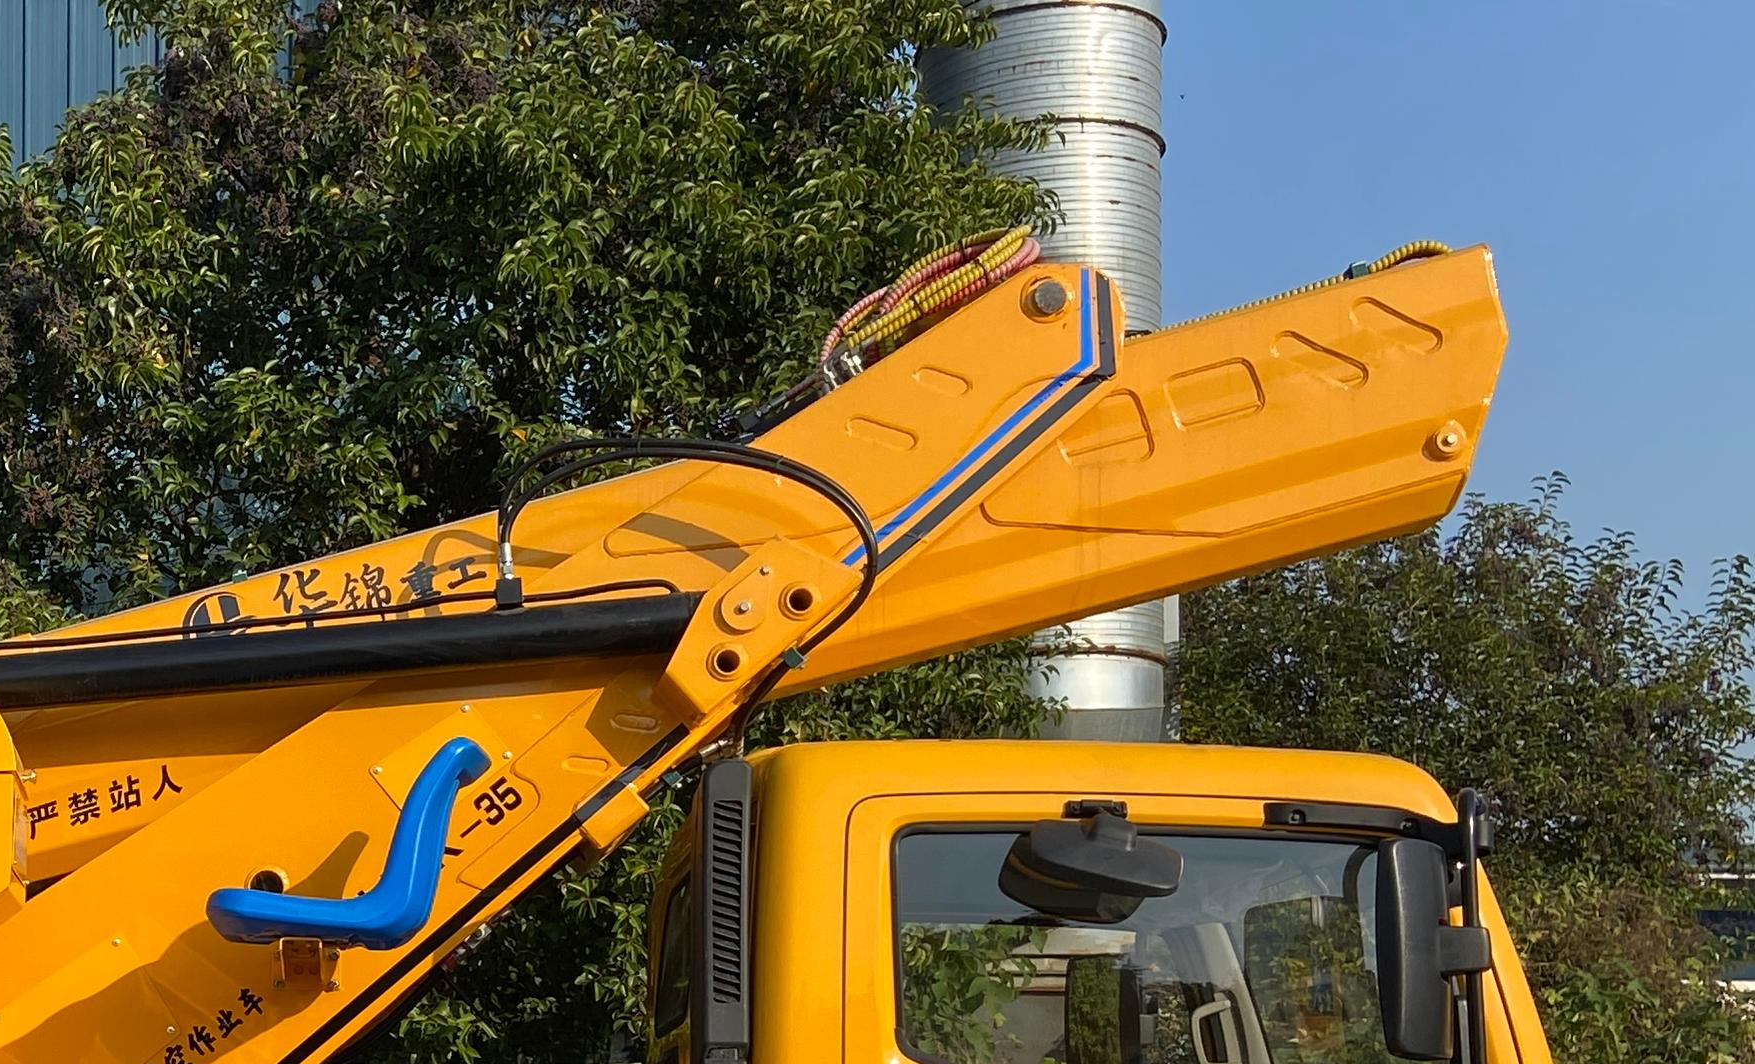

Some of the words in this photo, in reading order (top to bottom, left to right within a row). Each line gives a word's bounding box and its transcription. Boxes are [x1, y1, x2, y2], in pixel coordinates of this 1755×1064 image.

[272, 556, 488, 627] 华锦重工
[26, 764, 183, 840] 严禁站人
